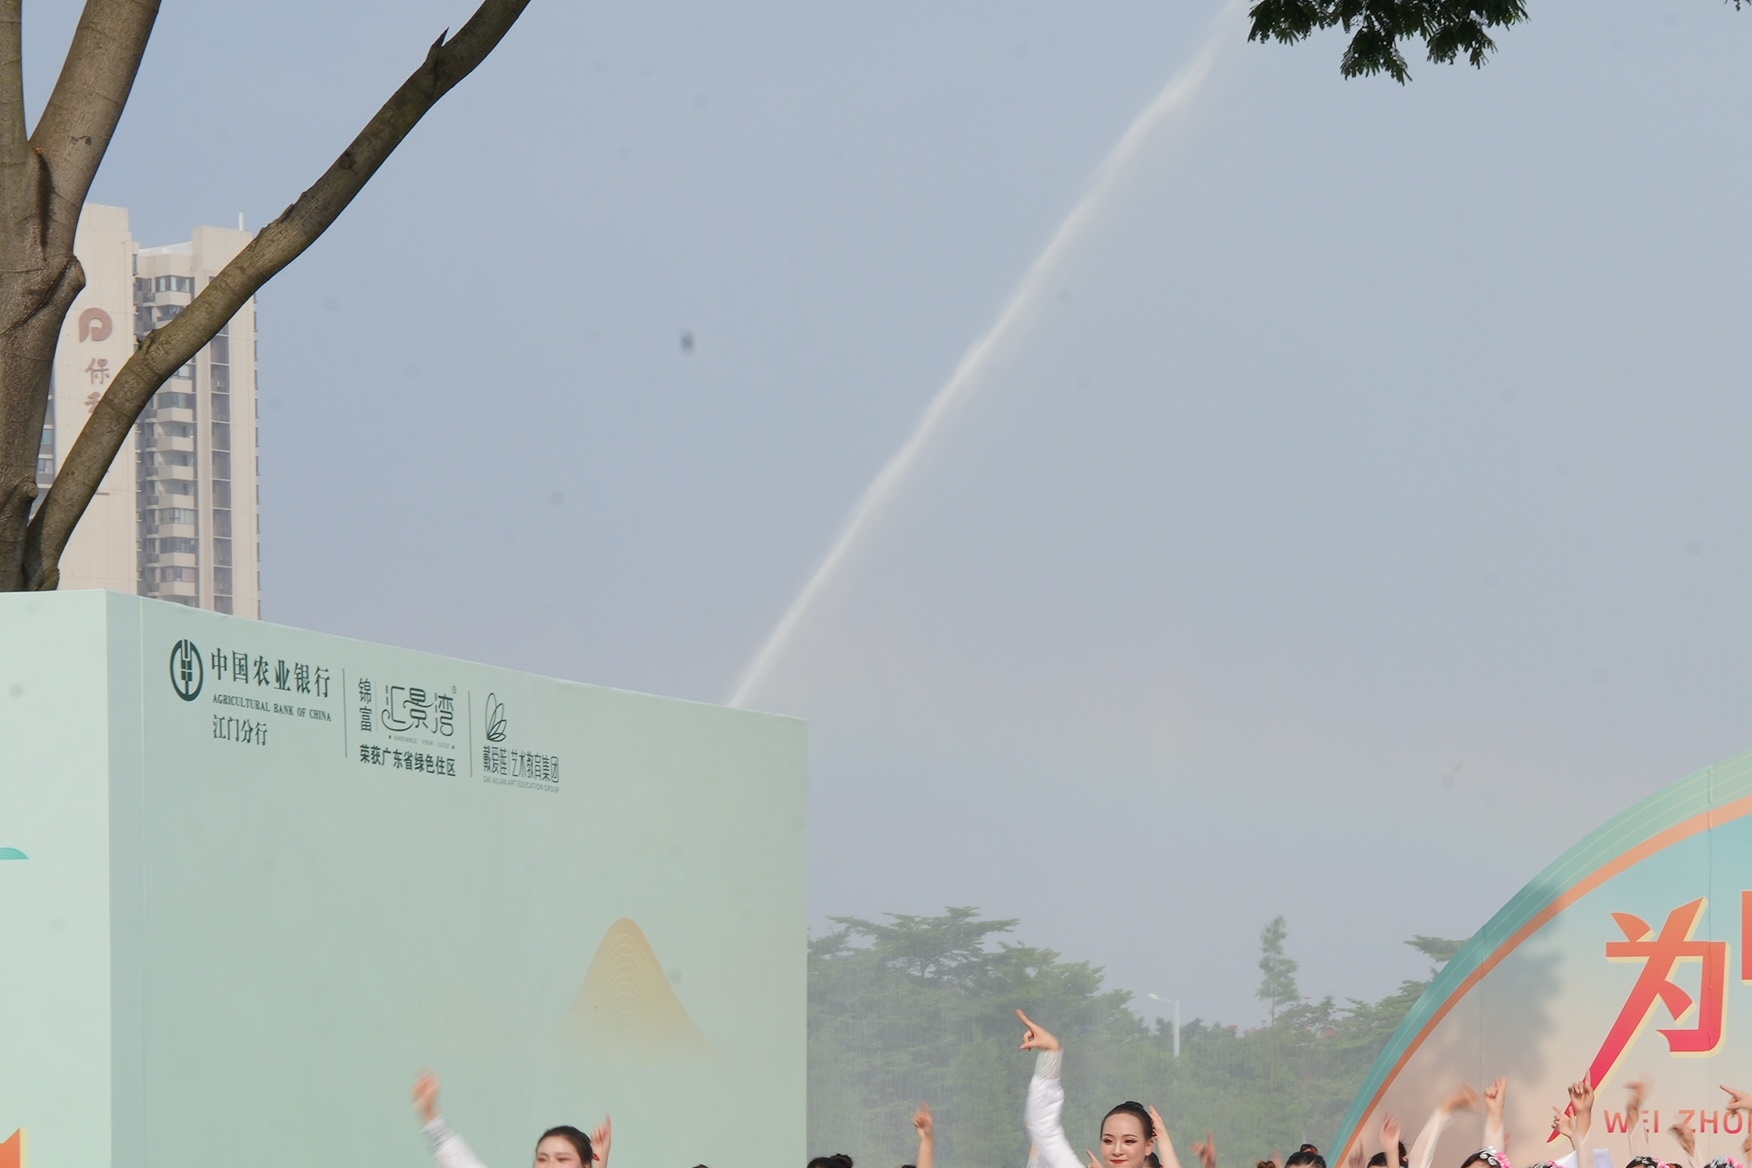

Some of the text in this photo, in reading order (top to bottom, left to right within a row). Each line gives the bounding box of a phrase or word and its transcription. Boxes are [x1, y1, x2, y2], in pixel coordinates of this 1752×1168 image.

[211, 647, 330, 698] 中国农业银行
[212, 693, 331, 722] AGRICULTURAL BANK OF CHINA
[358, 678, 372, 732] 锦富
[381, 685, 454, 737] 汇景湾
[213, 714, 267, 746] 江门分行
[360, 744, 456, 777] 荣获广东省绿色住区
